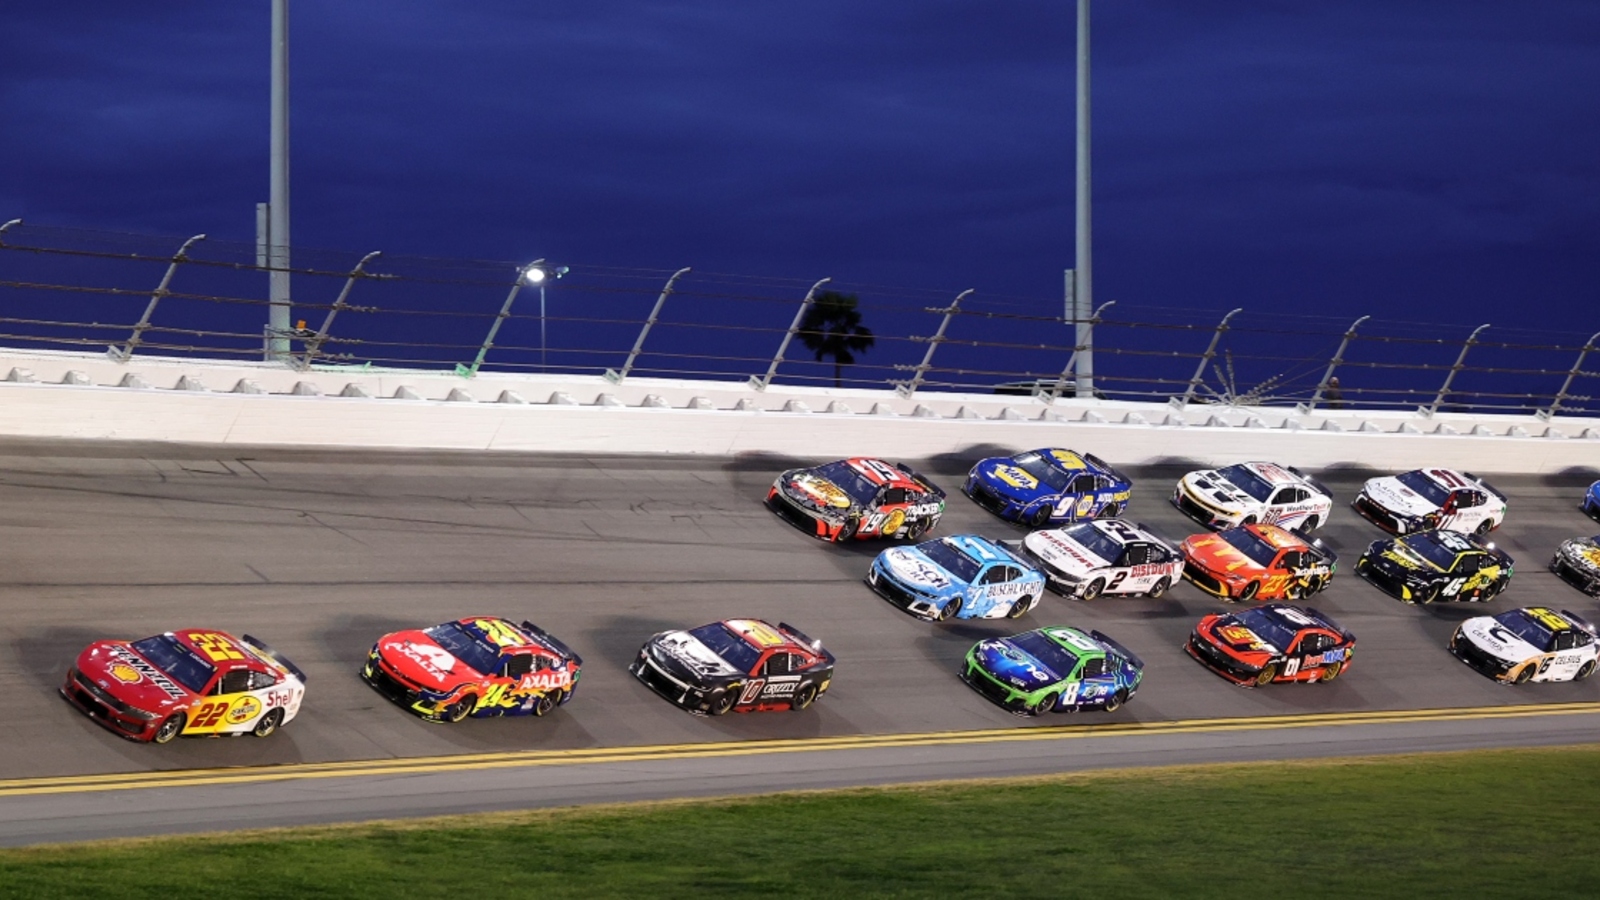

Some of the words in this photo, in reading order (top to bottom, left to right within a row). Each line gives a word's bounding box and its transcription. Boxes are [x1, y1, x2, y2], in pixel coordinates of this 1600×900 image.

[1050, 450, 1087, 469] 9
[859, 459, 900, 480] 19
[1052, 497, 1075, 516] 9
[861, 513, 884, 532] 19
[1105, 521, 1140, 540] 2
[1436, 515, 1456, 530] 11
[964, 538, 998, 559] 1
[1039, 531, 1094, 568] DISCOUNT
[1130, 562, 1175, 578] DISCOUNT
[1106, 571, 1128, 590] 2
[1260, 575, 1287, 593] 23
[1441, 577, 1467, 596] 45
[967, 587, 984, 609] 1
[188, 634, 245, 661] 22
[1048, 628, 1103, 651] 8
[384, 641, 448, 682] AXALTA
[1284, 658, 1301, 676] 01
[1538, 656, 1555, 674] 16
[1555, 655, 1582, 665] CELSIUS
[520, 671, 570, 691] AXALTA
[763, 682, 799, 696] GRIZZLY
[265, 688, 294, 707] Shell
[472, 683, 510, 714] 24
[737, 679, 766, 704] 10
[1062, 682, 1081, 705] 8
[188, 702, 229, 728] 22
